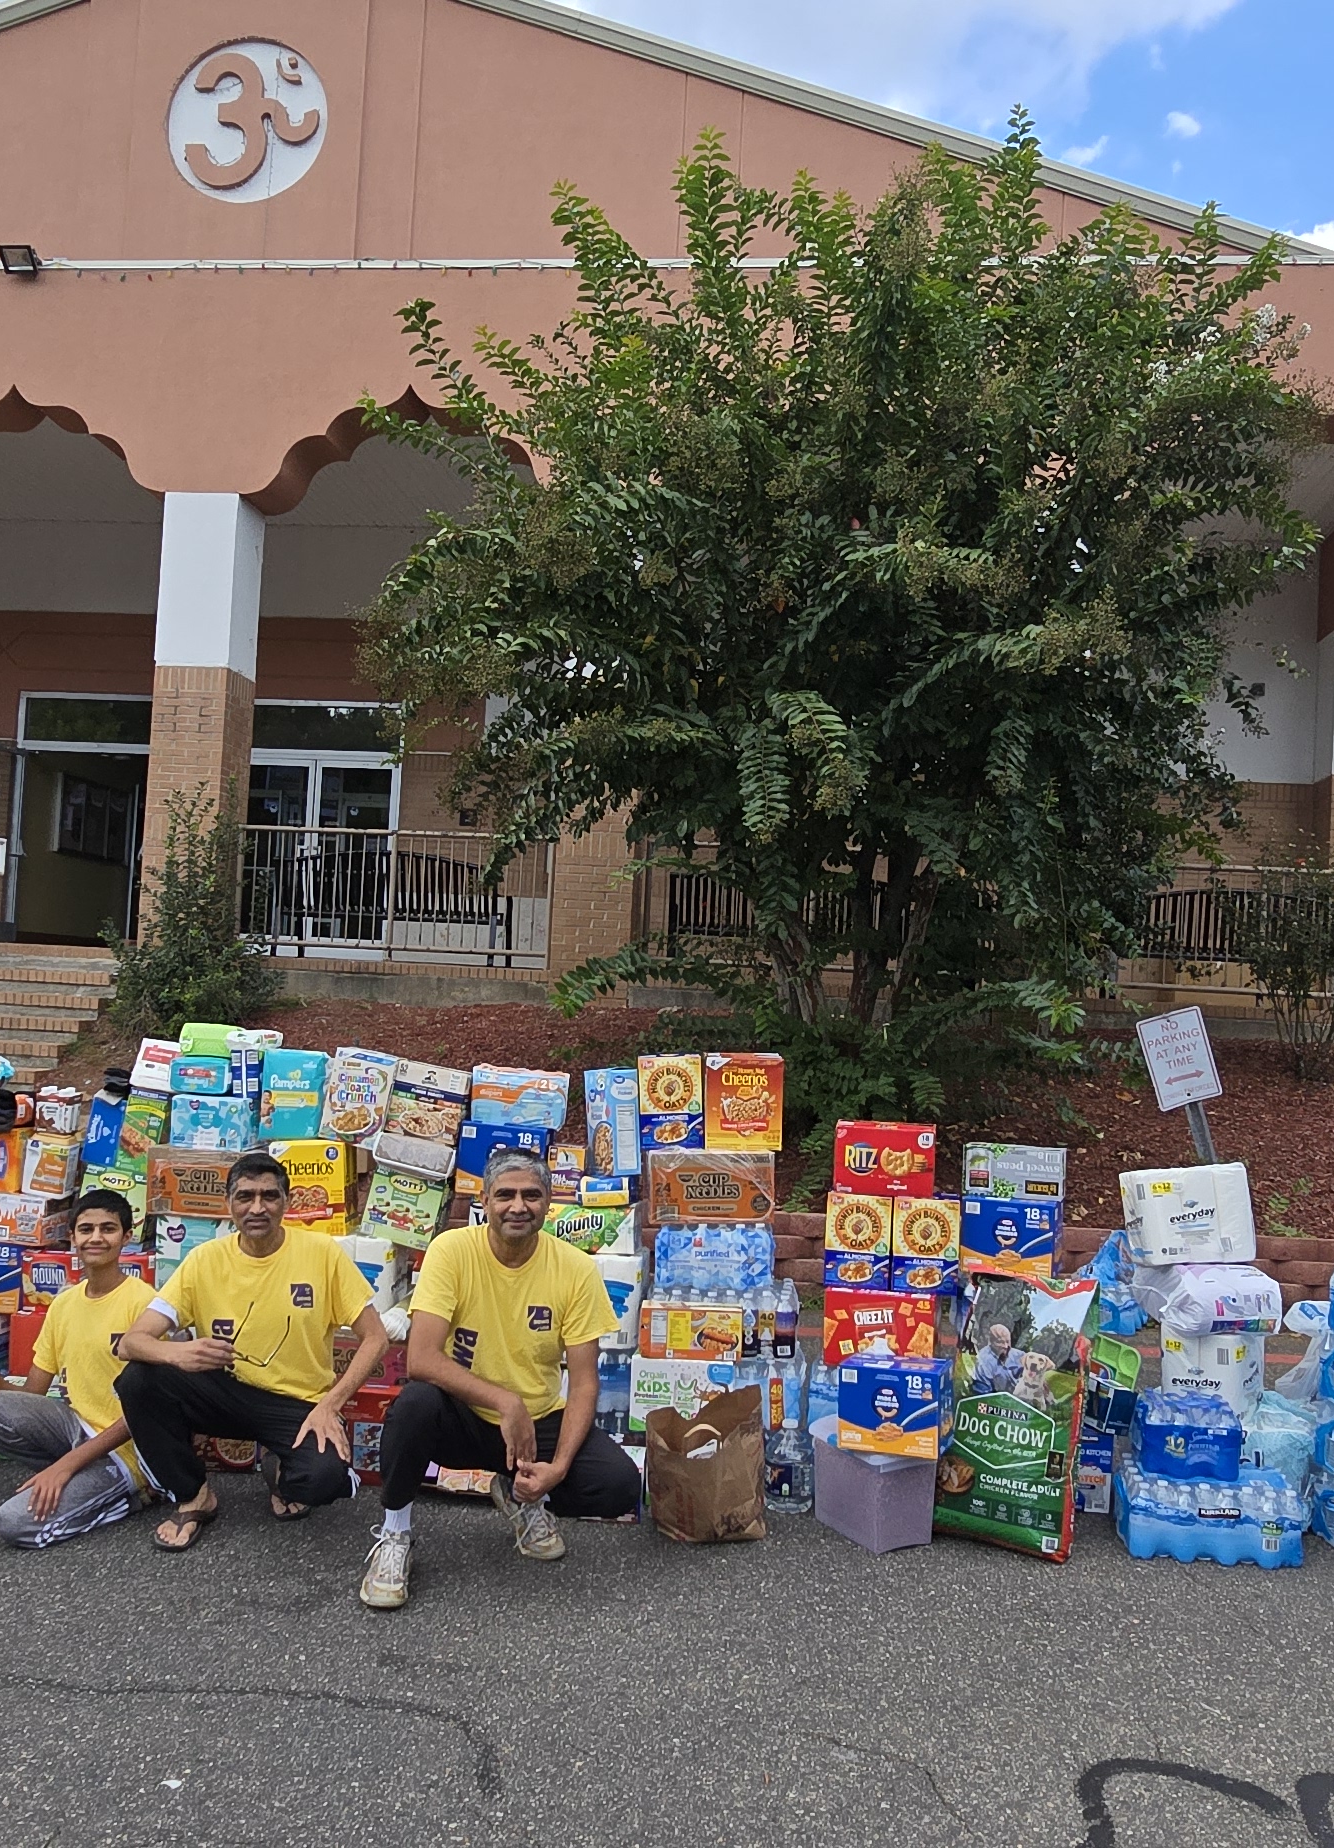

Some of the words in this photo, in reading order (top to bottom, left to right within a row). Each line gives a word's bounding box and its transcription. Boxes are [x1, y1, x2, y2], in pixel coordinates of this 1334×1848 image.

[1160, 1020, 1179, 1033] NO
[1147, 1027, 1201, 1050] PARKING
[1155, 1048, 1170, 1061] AT
[1174, 1040, 1198, 1056] ANY
[1165, 1055, 1195, 1070] TIME
[270, 1075, 310, 1090] Pampers
[338, 1072, 380, 1085] Cinnamon
[721, 1072, 768, 1087] Cheerios
[344, 1082, 371, 1094] Toast
[337, 1091, 377, 1104] Crunch
[517, 1132, 533, 1144] 18
[844, 1144, 879, 1169] RITZ
[996, 1161, 1025, 1171] peas
[1027, 1163, 1061, 1173] sweet
[102, 1175, 133, 1188] MOTT'S
[190, 1169, 219, 1183] CUP
[698, 1172, 730, 1186] CUP
[178, 1180, 227, 1195] NOODLES
[392, 1178, 425, 1192] MOTT'S
[685, 1183, 742, 1200] NOODLES
[838, 1206, 854, 1231] HONEY
[855, 1205, 880, 1234] BUNCHES
[1024, 1207, 1041, 1220] 18
[1169, 1206, 1216, 1224] everyday
[556, 1213, 604, 1239] Bounty
[906, 1211, 923, 1236] HONEY
[923, 1210, 948, 1239] BUNCHES
[850, 1236, 875, 1249] OATS
[918, 1241, 943, 1254] OATS
[694, 1249, 730, 1259] purified
[32, 1267, 66, 1285] ROUND
[639, 1369, 668, 1381] Orgain
[905, 1375, 923, 1389] 18
[1171, 1377, 1222, 1391] everyday
[987, 1406, 1027, 1421] PURINA
[957, 1411, 991, 1436] DOG
[994, 1420, 1049, 1448] CHOW
[979, 1473, 1029, 1492] COMPLETE
[1030, 1484, 1062, 1498] ADULT
[979, 1483, 1010, 1495] CHICKEN
[1010, 1489, 1039, 1501] FLAVOR
[1200, 1508, 1241, 1517] KIRKLAND
